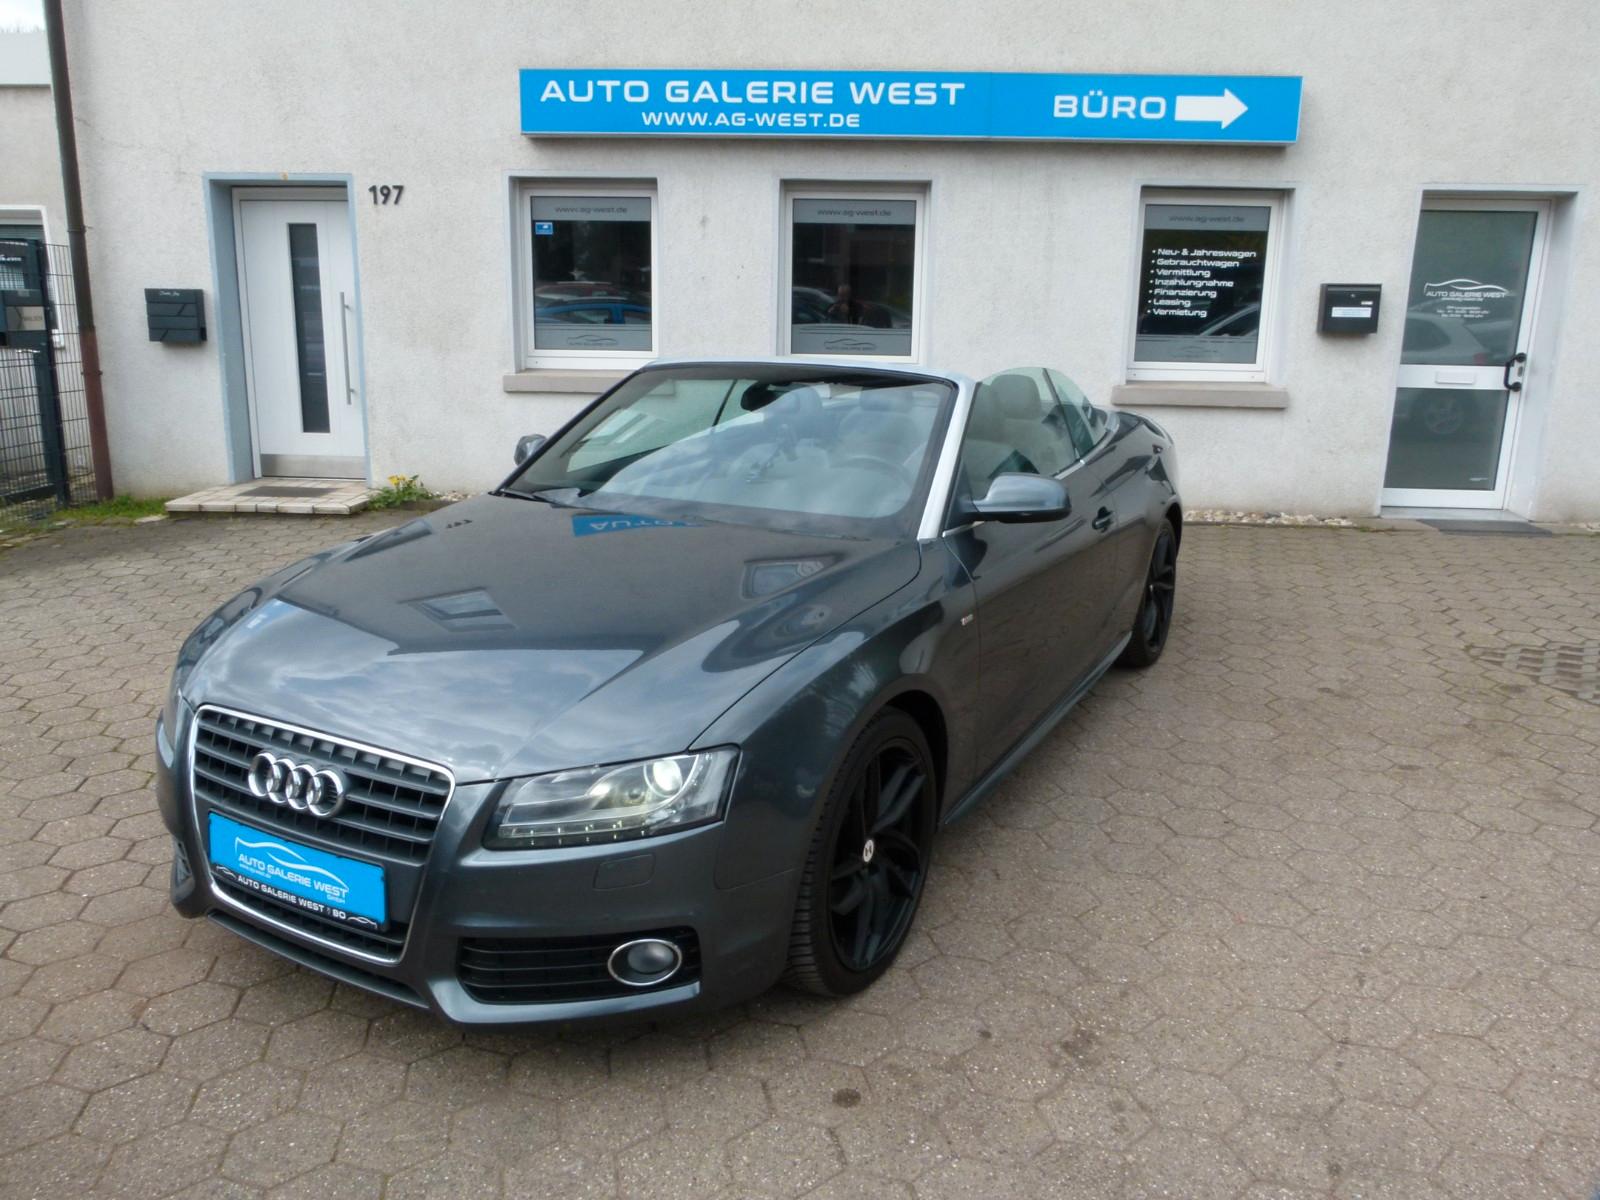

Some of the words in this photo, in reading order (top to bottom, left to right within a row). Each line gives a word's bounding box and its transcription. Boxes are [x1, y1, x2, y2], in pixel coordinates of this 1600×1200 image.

[540, 80, 649, 103] AUTO
[665, 80, 834, 104] GALERIE
[849, 82, 965, 105] WEST
[1053, 90, 1166, 119] BÜRO
[642, 112, 860, 127] WWW.AG-WEST.DE
[368, 185, 404, 205] 197
[1181, 248, 1188, 256] &
[1190, 249, 1257, 259] Jahreswagen
[1156, 258, 1240, 268] Gebrauchtwagen
[1156, 268, 1211, 278] Vermittlung
[1154, 278, 1234, 288] Inzahlungnahme
[1153, 288, 1217, 298] Finanzierung
[1153, 298, 1191, 307] Leasing
[1152, 308, 1207, 318] Vermietung
[238, 853, 265, 871] AUTO
[266, 864, 312, 887] GALERIE
[313, 880, 348, 898] WEST
[238, 875, 260, 889] AUTO
[260, 883, 297, 904] GALERIE
[298, 898, 325, 913] WEST
